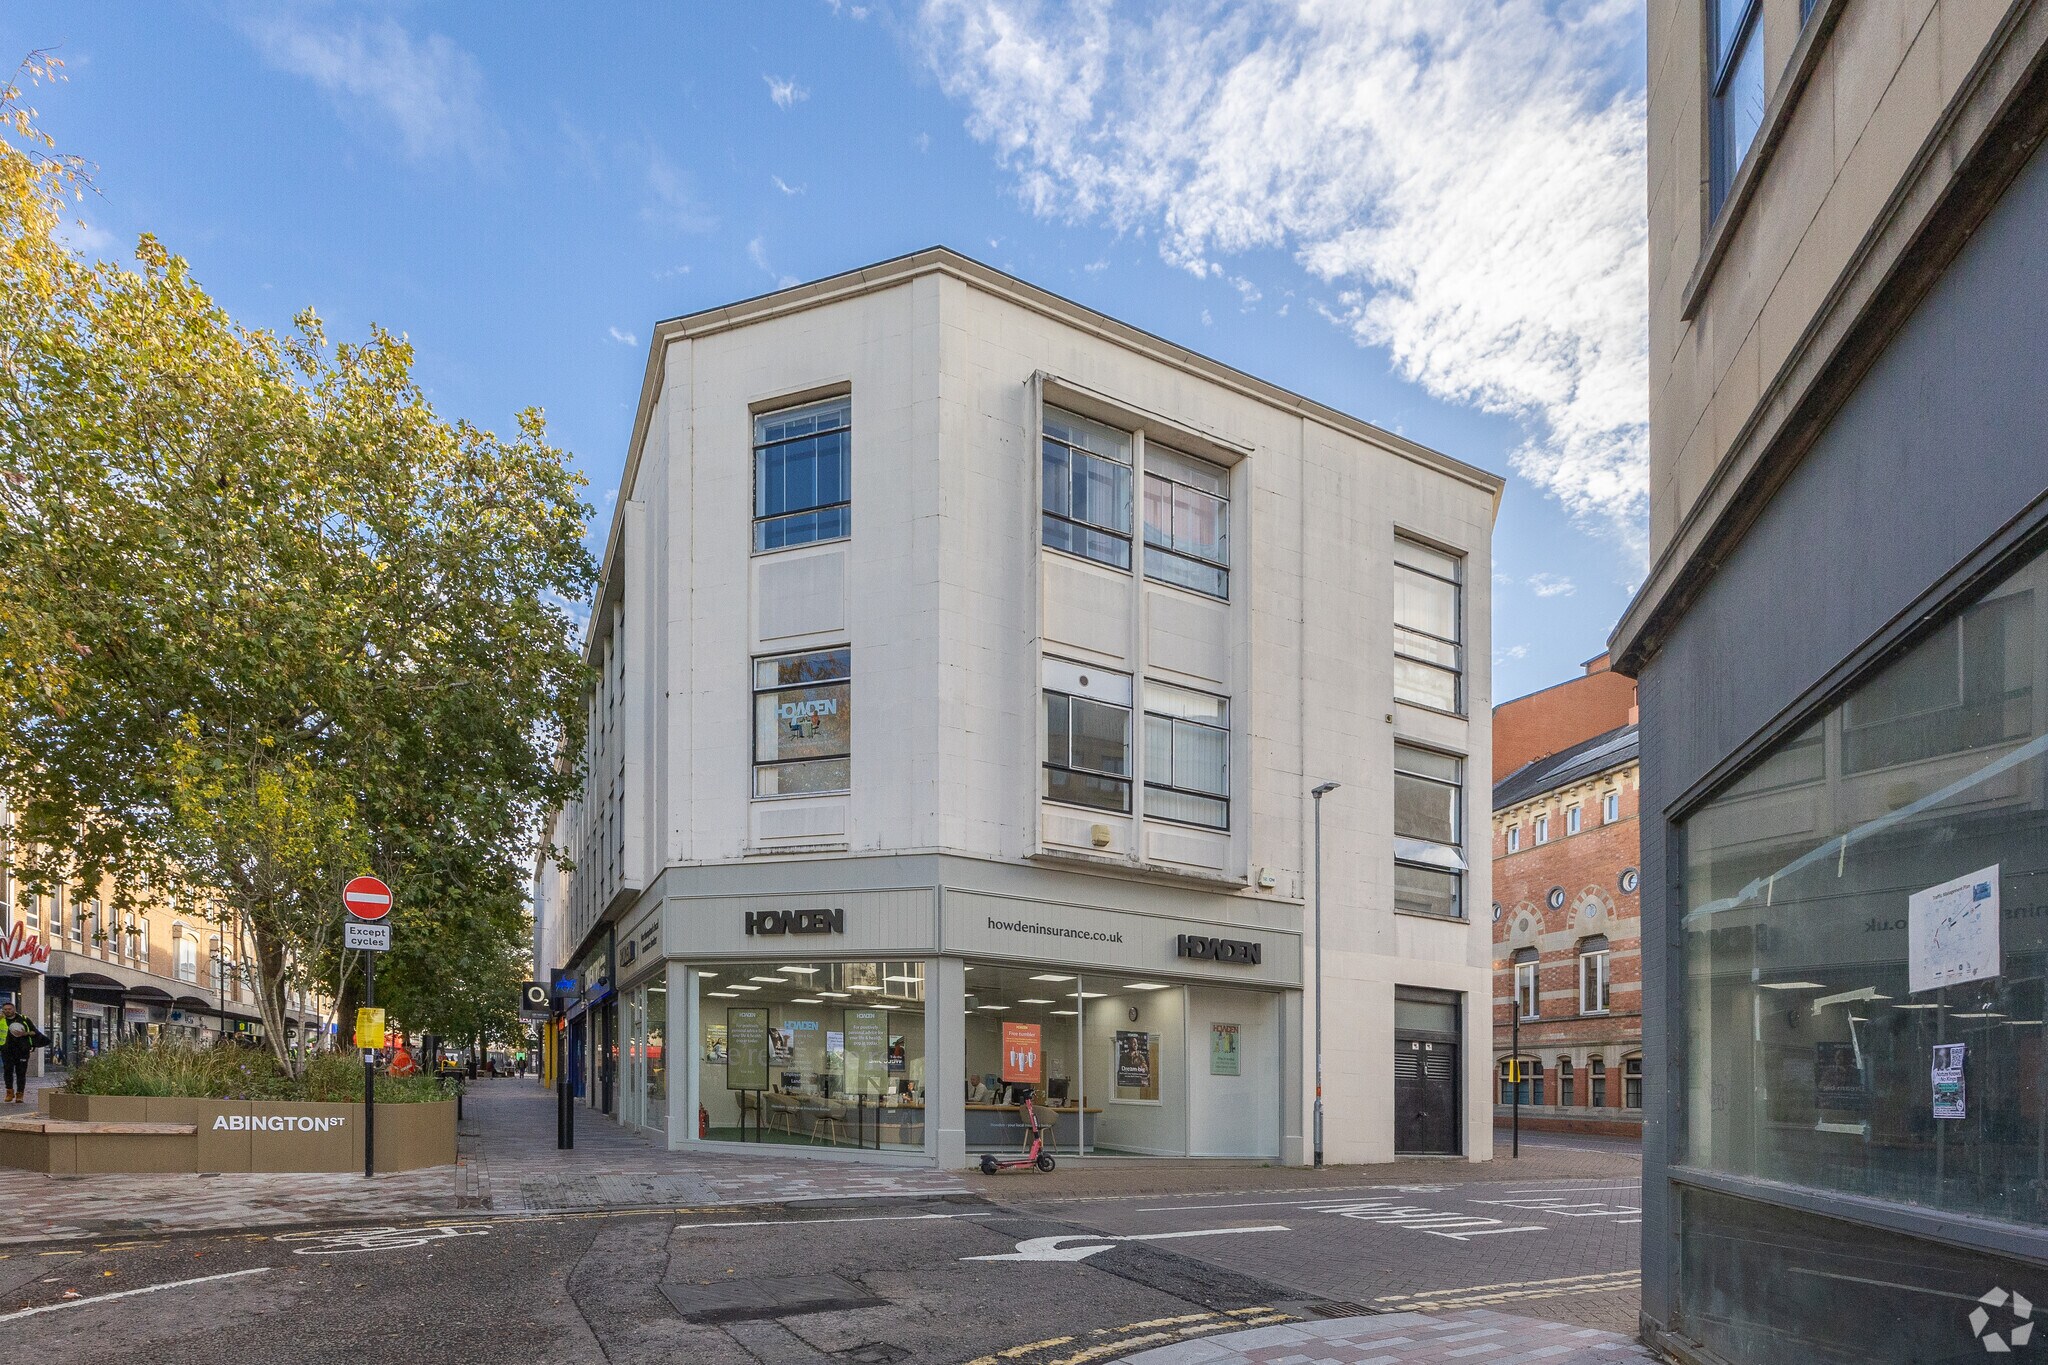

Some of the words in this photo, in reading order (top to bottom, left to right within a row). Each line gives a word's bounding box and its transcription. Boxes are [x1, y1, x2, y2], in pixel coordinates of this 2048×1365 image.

[774, 699, 837, 720] HOWDEN
[349, 926, 386, 937] Except
[745, 908, 844, 935] HOWDEN
[987, 916, 1124, 945] howdeninsurance.co.uk
[350, 938, 384, 946] cycles
[1176, 933, 1262, 965] HOWDEN
[783, 1021, 819, 1031] HOWDEN
[1137, 1065, 1146, 1073] big
[1297, 1202, 1550, 1241] TURN
[1466, 1197, 1642, 1223] EFT
